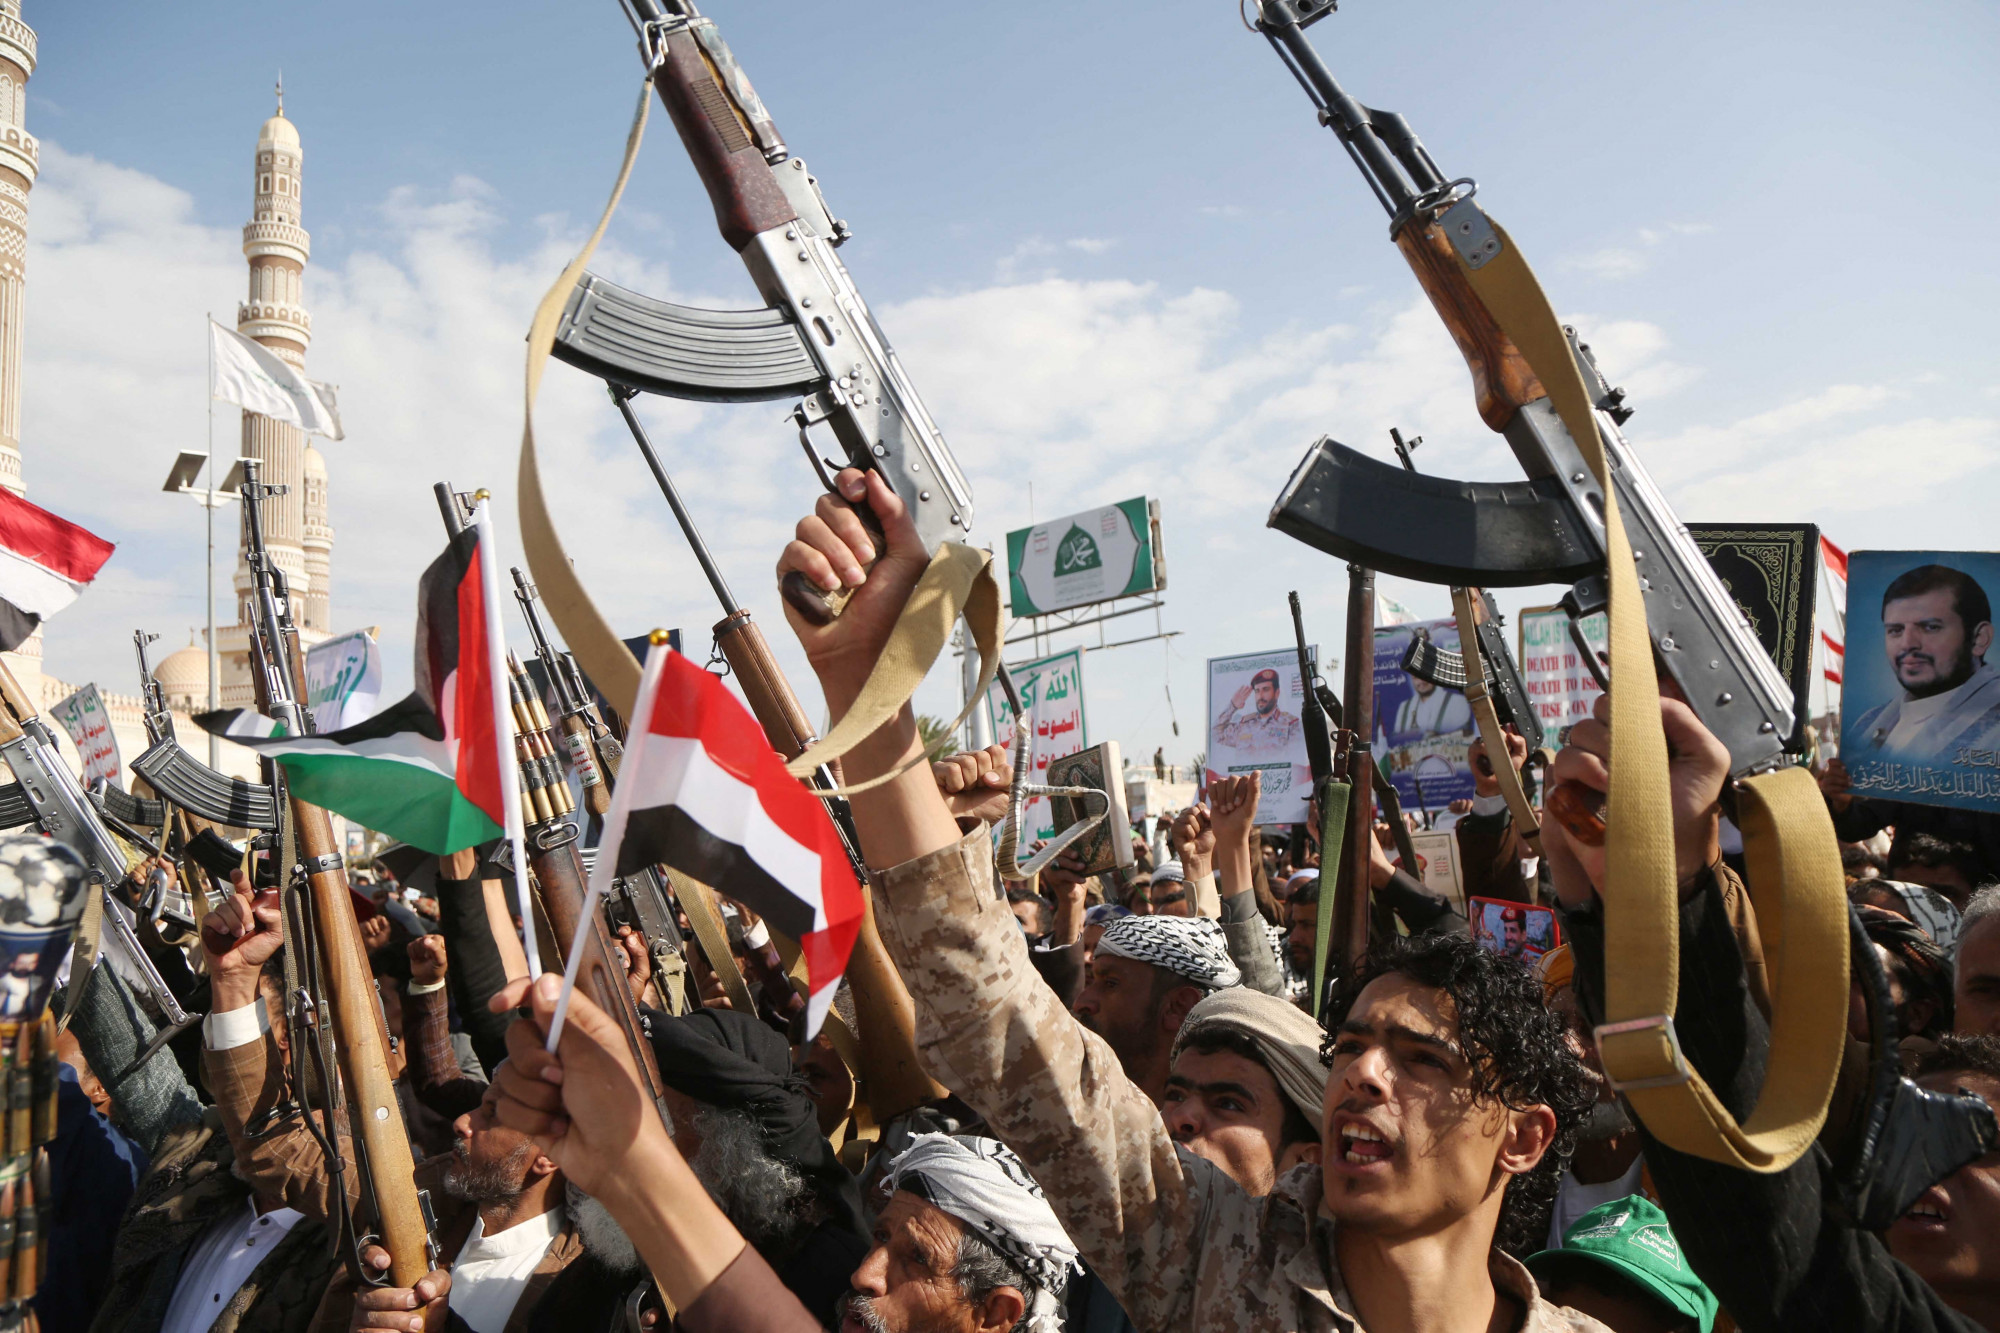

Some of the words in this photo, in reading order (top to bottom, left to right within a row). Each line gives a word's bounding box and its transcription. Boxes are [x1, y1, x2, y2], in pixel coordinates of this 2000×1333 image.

[1527, 657, 1559, 672] DEATH
[1563, 654, 1576, 669] TO
[1528, 677, 1561, 695] DEATH
[1565, 674, 1578, 691] TO
[1573, 700, 1588, 715] ON
[1038, 709, 1080, 741] الموت
